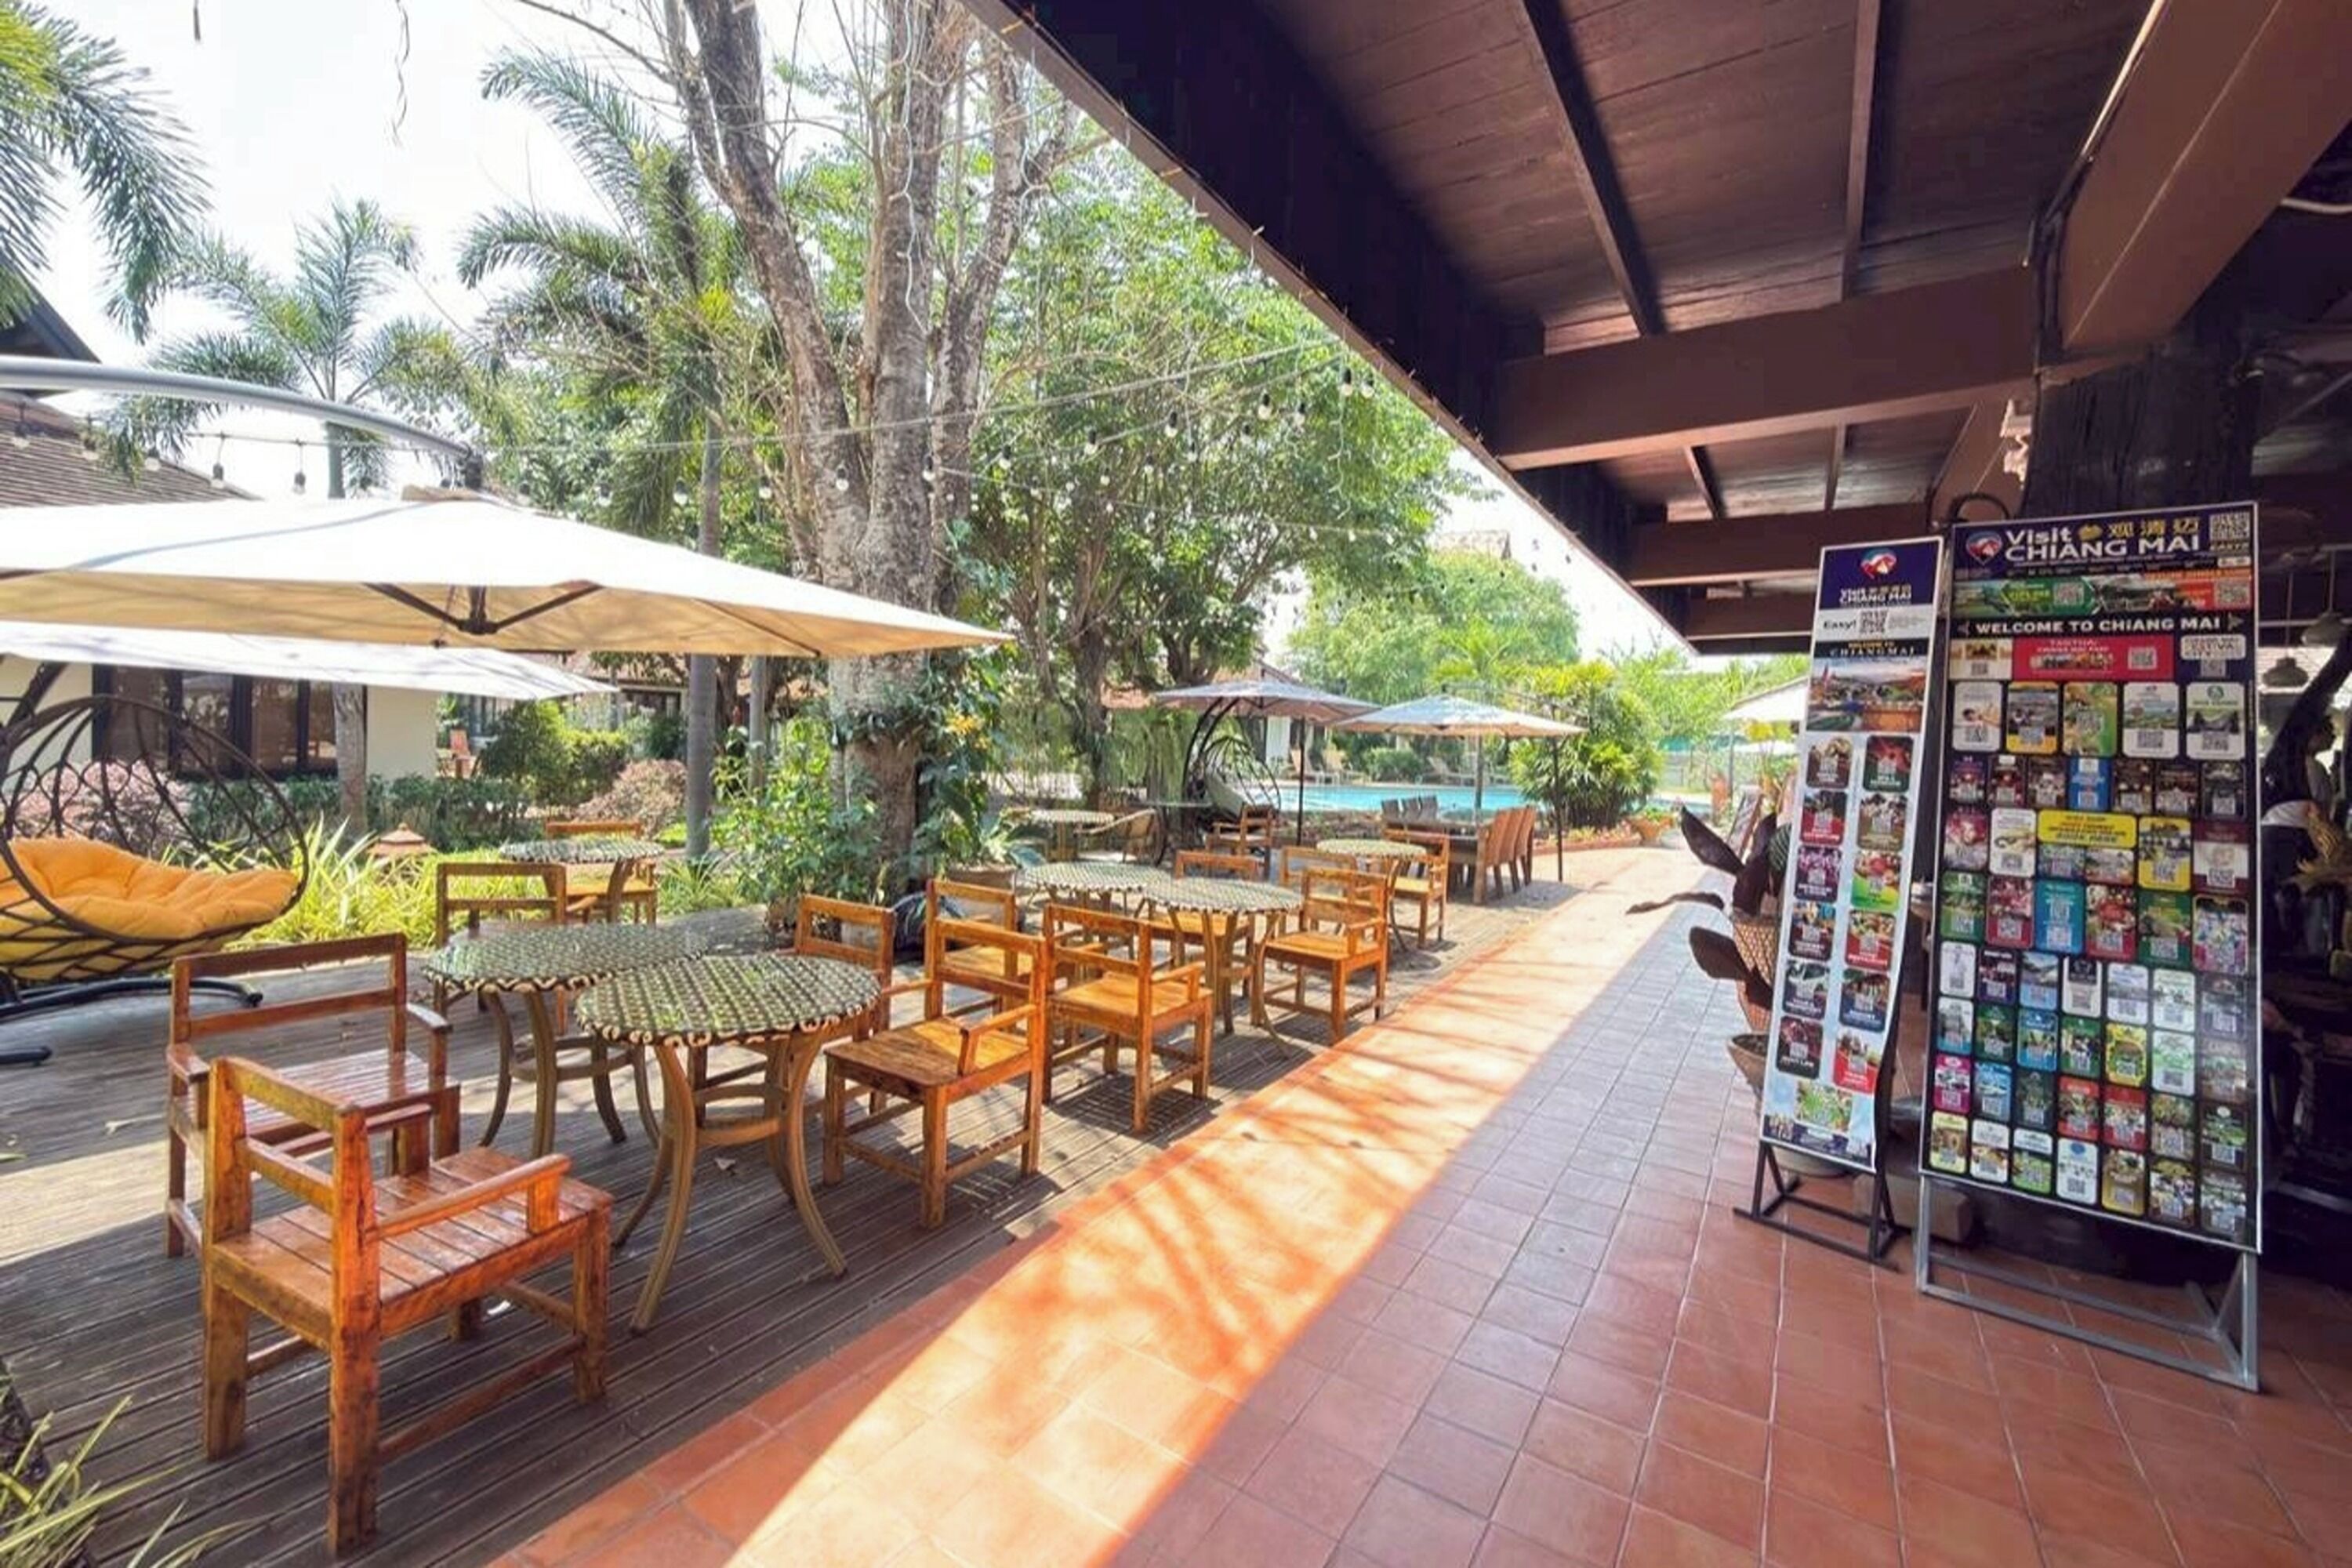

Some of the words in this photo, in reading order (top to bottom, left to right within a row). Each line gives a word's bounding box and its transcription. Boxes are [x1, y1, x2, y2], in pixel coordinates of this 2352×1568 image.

[2005, 527, 2072, 546] Visit
[2005, 540, 2128, 562] CHIANG
[2138, 535, 2199, 555] MAI
[1975, 620, 2063, 633] WELCOME
[2068, 620, 2093, 633] TO
[2180, 616, 2220, 630] MAI
